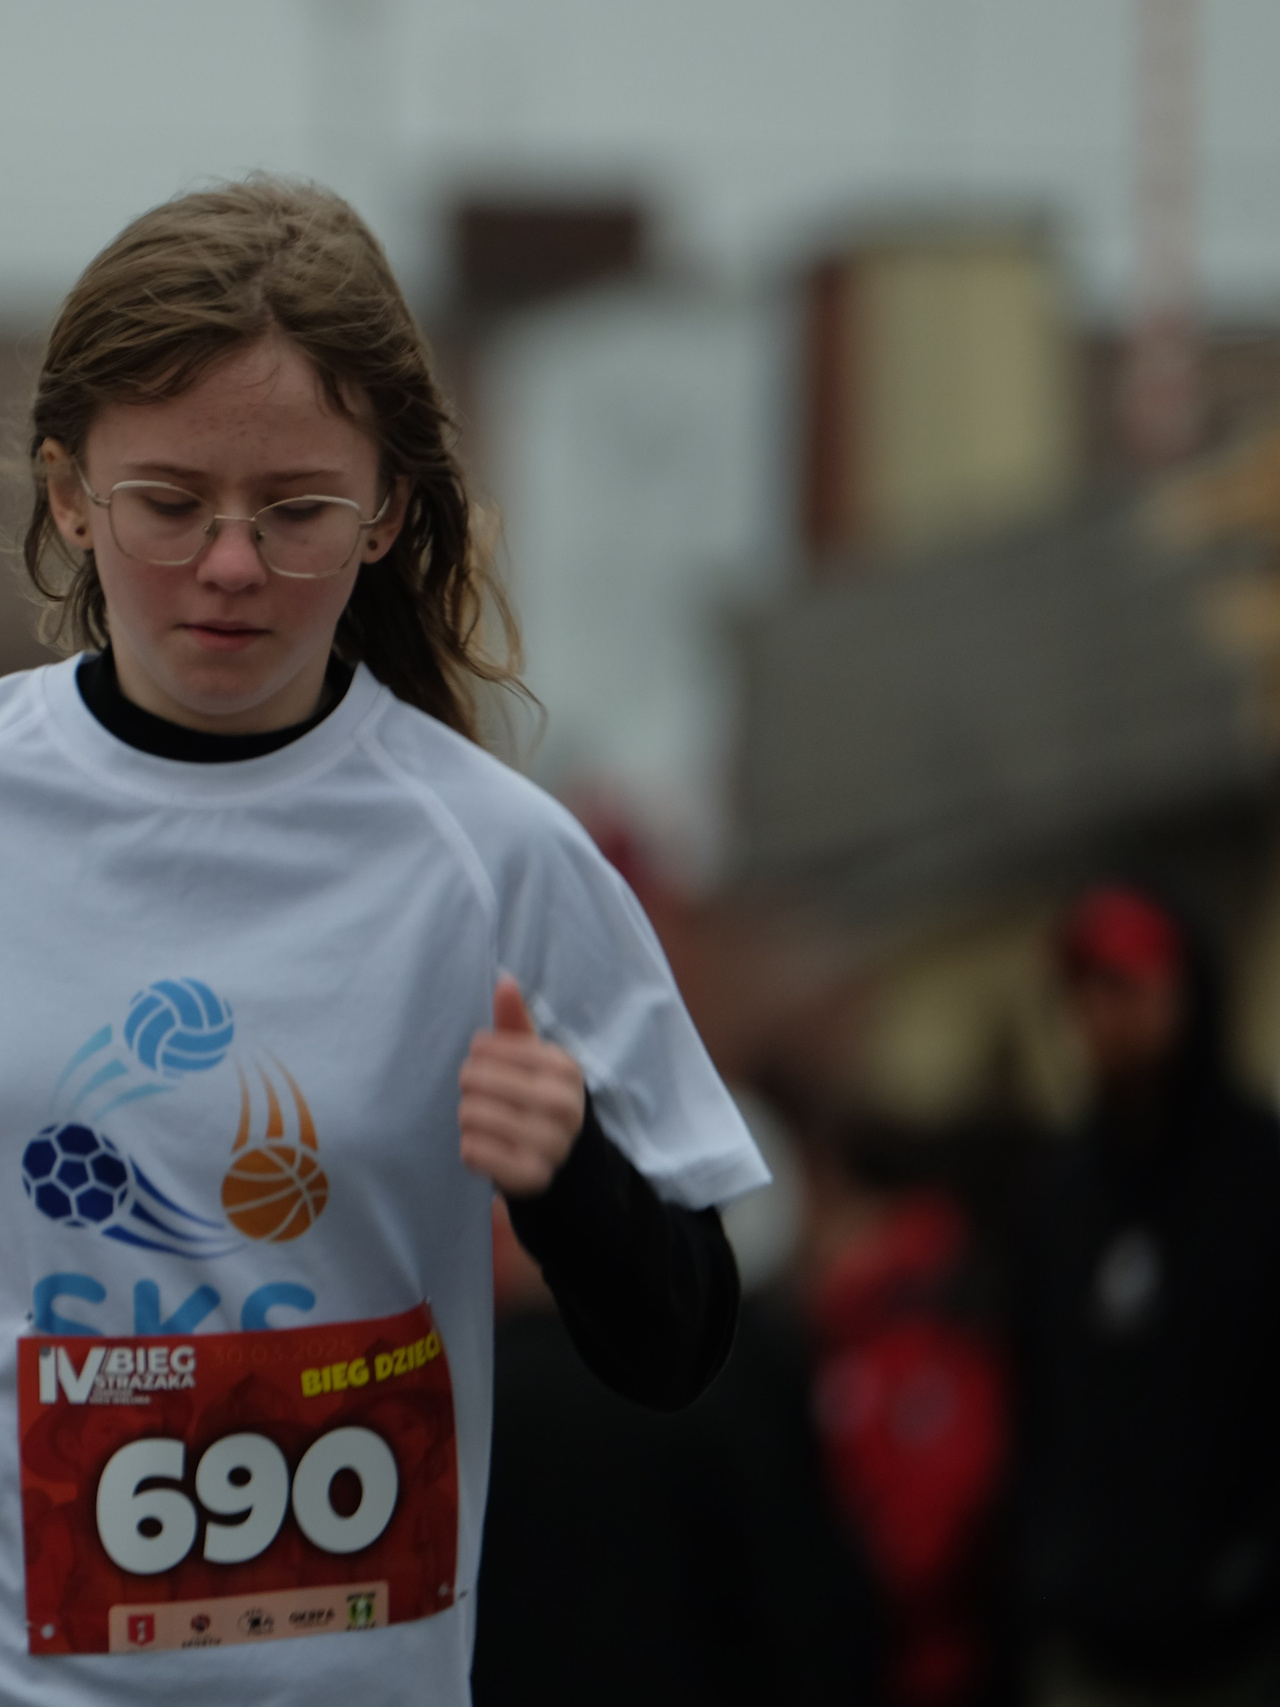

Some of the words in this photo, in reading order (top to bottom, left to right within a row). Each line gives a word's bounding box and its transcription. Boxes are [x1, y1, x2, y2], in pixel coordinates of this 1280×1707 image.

[40, 1345, 108, 1405] IV
[105, 1345, 197, 1375] BIEG
[301, 1357, 370, 1398] BIEG
[95, 1426, 399, 1576] 690
